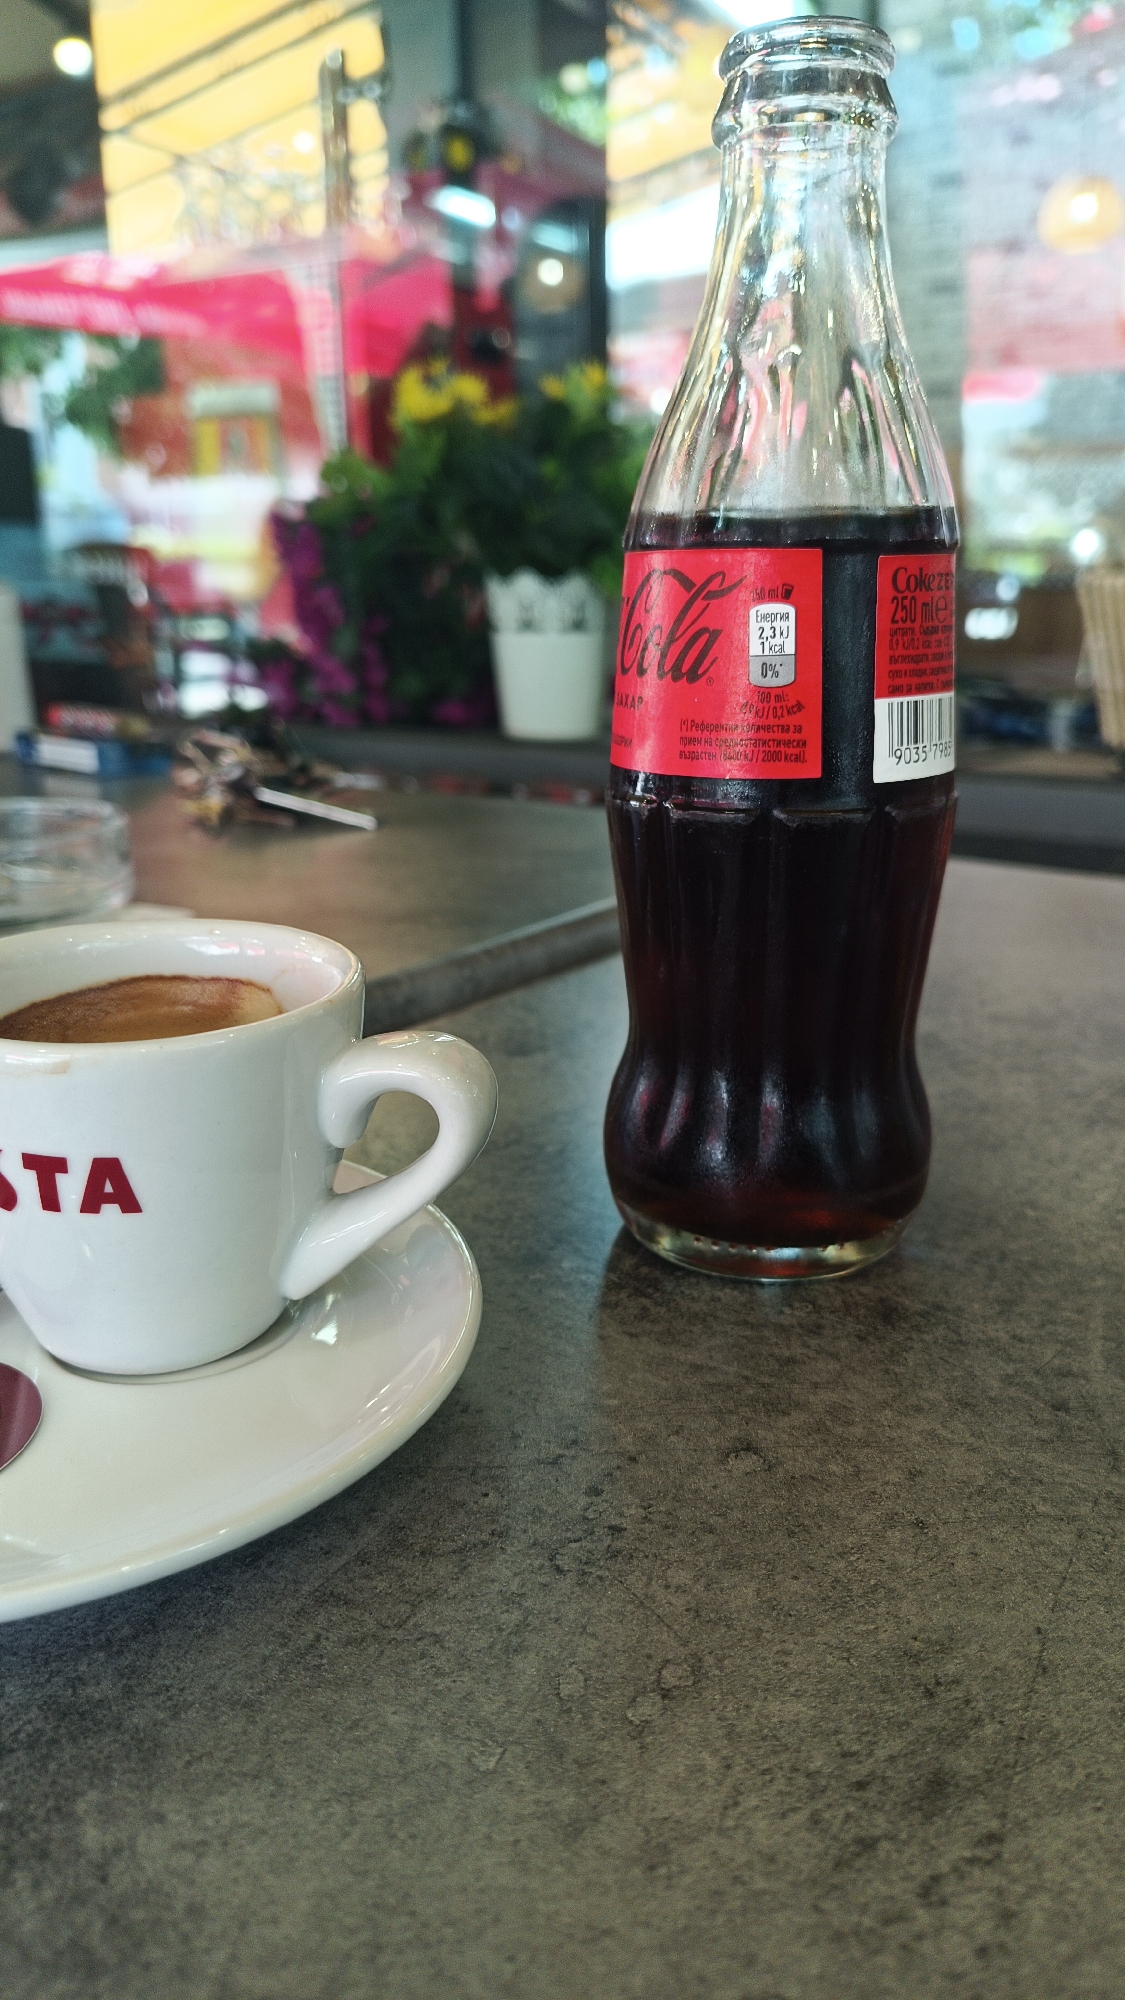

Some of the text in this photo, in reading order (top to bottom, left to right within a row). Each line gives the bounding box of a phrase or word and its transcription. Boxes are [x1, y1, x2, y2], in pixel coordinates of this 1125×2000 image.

[891, 566, 936, 594] Coke
[750, 586, 779, 602] 250 ml
[756, 610, 790, 626] Енергия
[890, 595, 917, 625] 250
[621, 568, 751, 684] Cola
[758, 626, 790, 643] 2,3 kJ
[760, 641, 786, 654] 1 kcal
[757, 690, 771, 704] 100
[772, 705, 785, 721] 0,2
[785, 699, 806, 717] kcal
[792, 724, 803, 735] за
[679, 736, 703, 749] прием
[704, 736, 713, 747] на
[678, 750, 717, 763] възрастен
[761, 750, 783, 763] 2000
